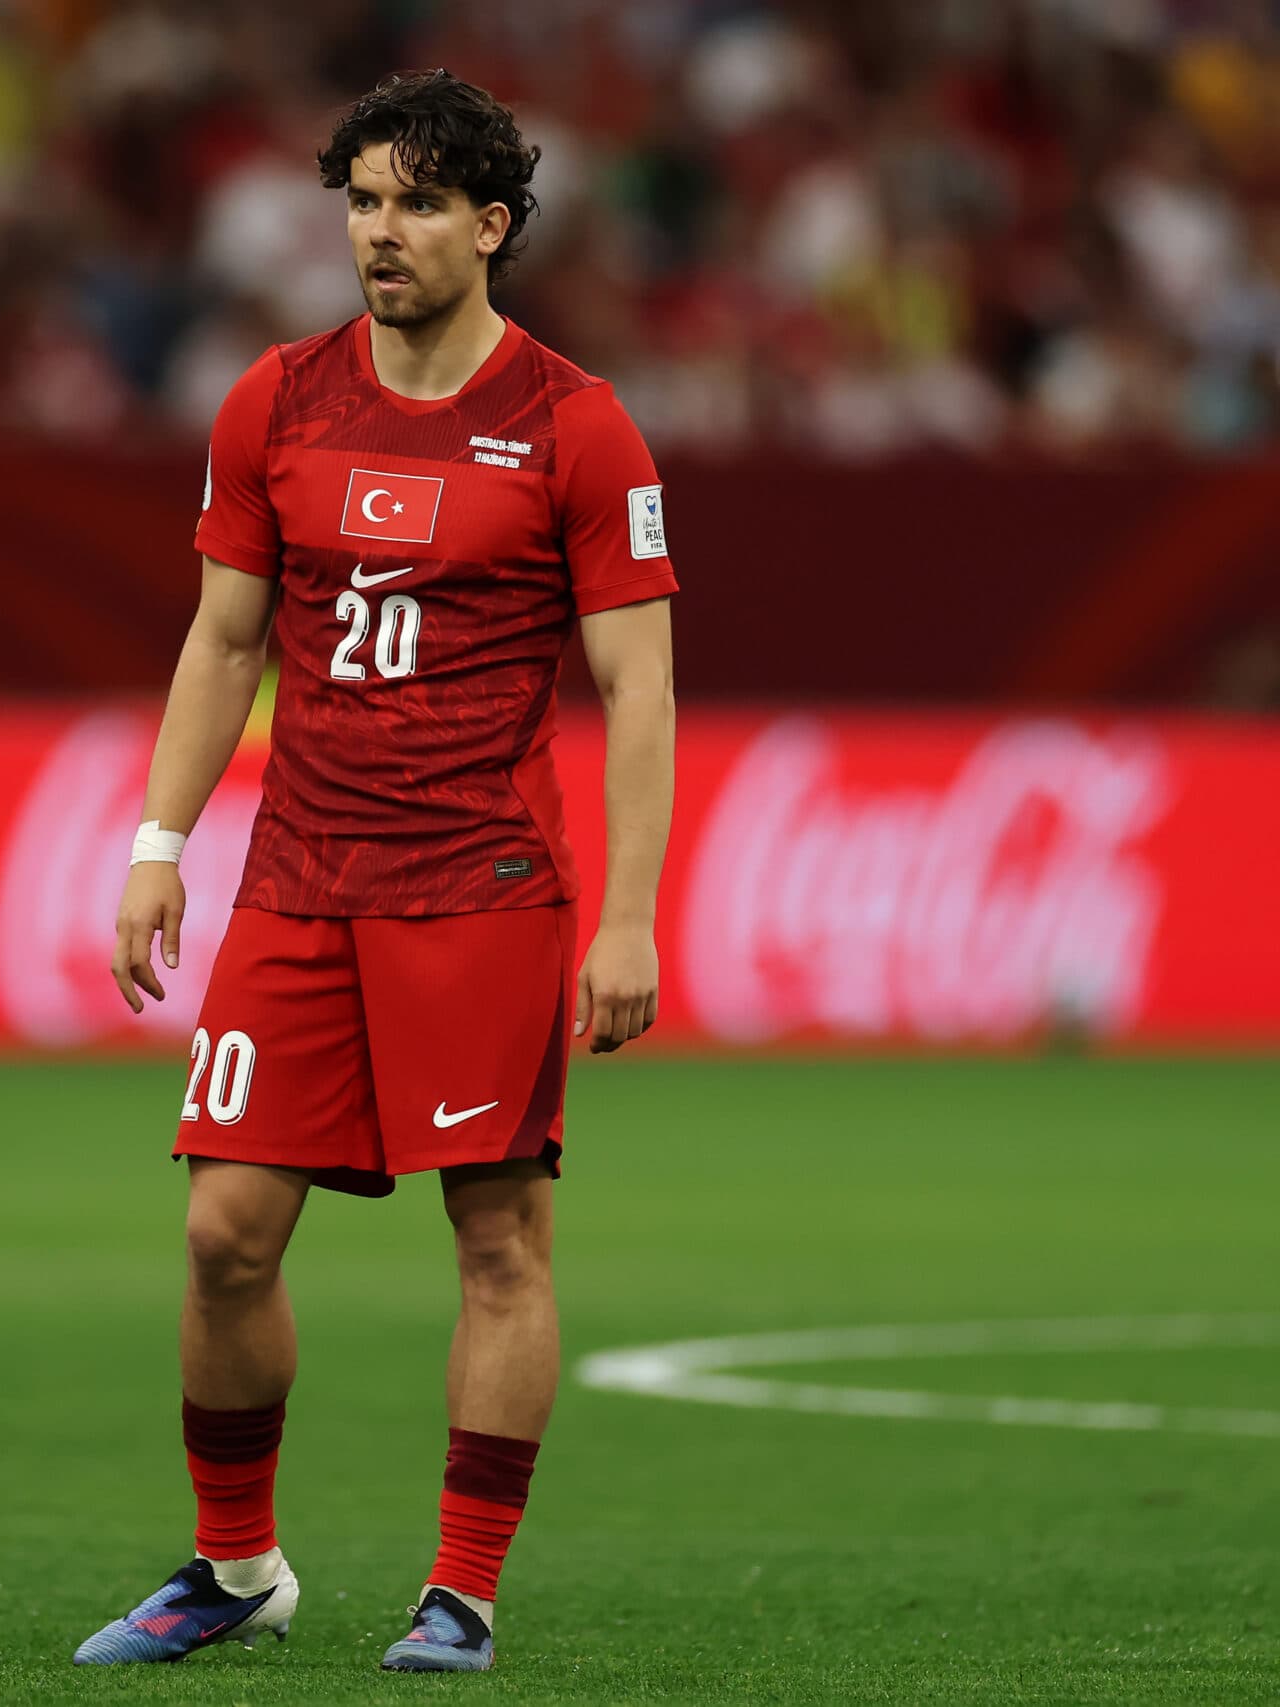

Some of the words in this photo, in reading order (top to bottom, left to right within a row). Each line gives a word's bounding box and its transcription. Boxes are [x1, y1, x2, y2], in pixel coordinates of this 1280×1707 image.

[645, 529, 663, 542] PEAC
[330, 590, 420, 680] 20
[181, 1027, 256, 1126] 20
